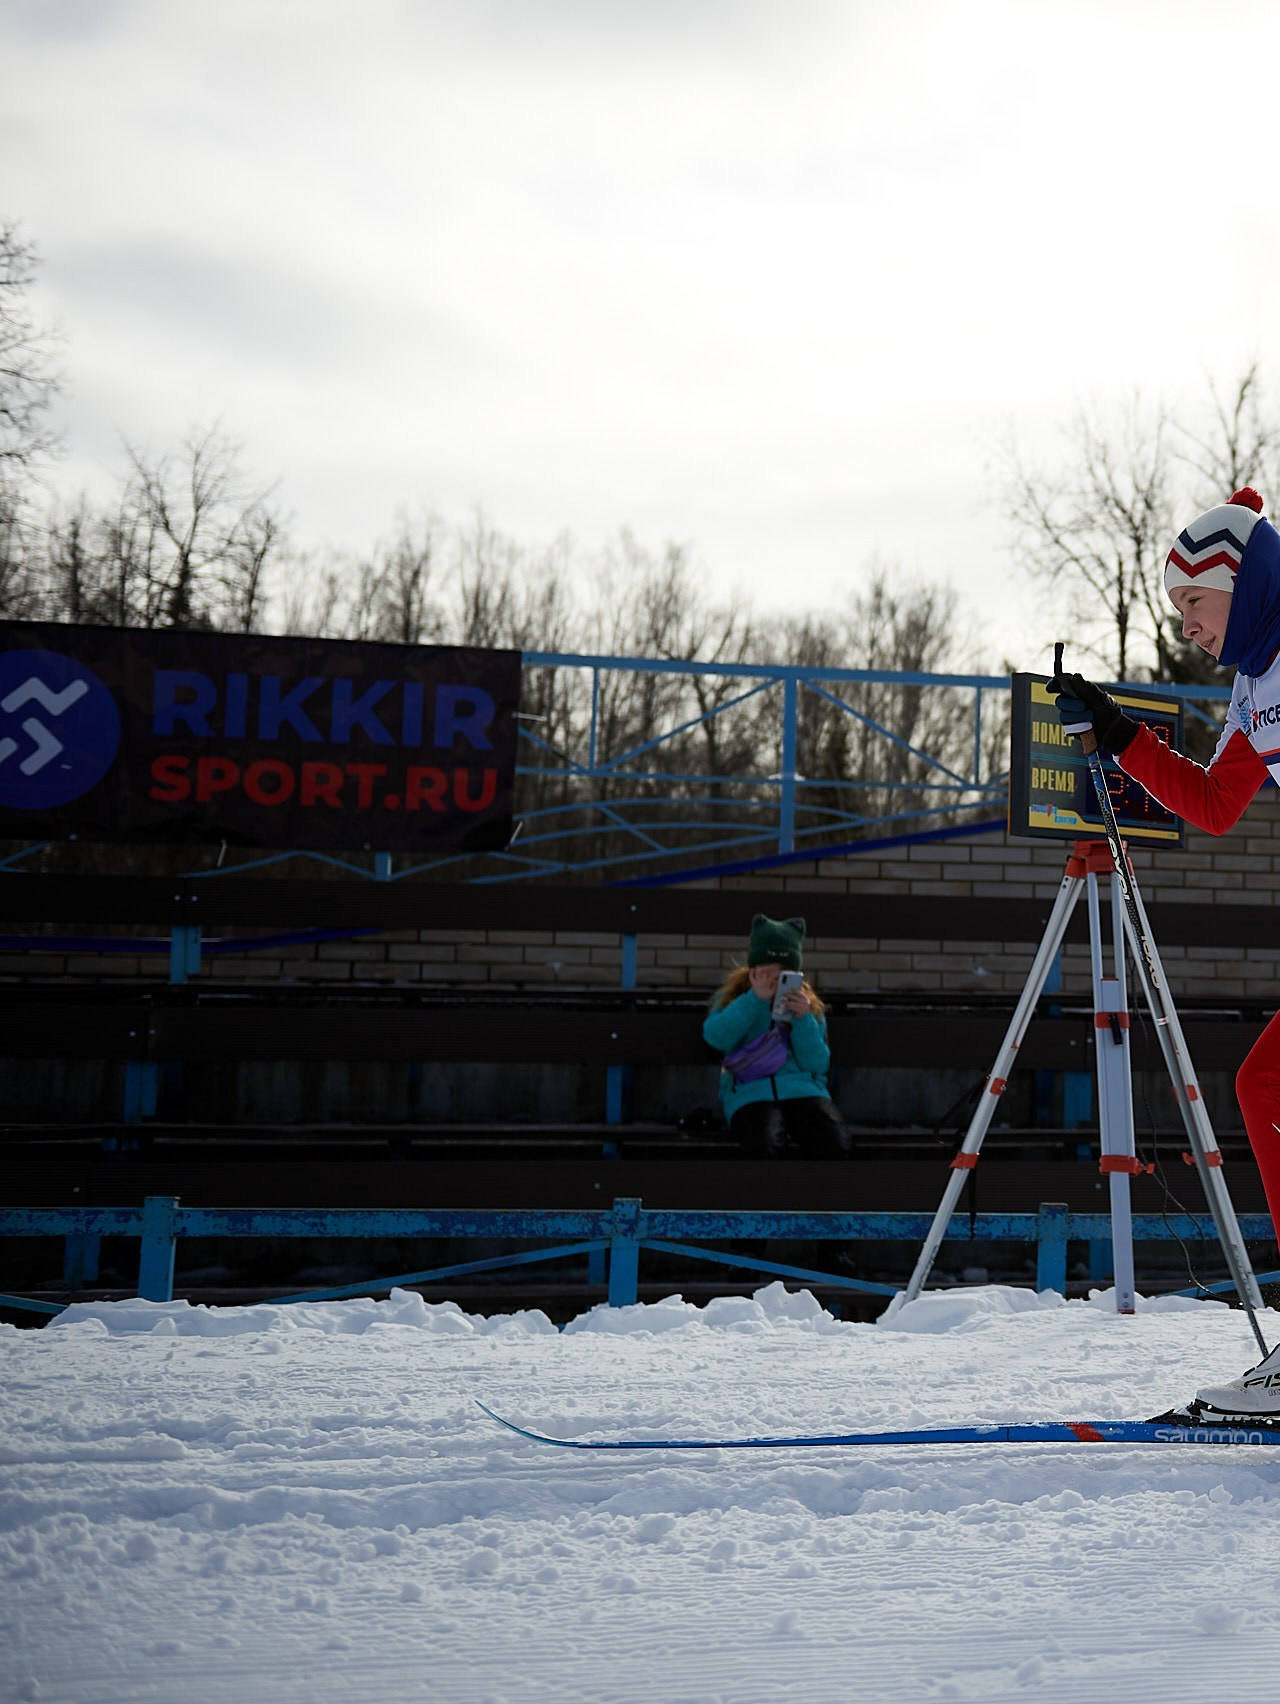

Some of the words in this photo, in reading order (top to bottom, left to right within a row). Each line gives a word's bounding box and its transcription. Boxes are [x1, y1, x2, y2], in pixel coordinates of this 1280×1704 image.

[152, 669, 497, 750] RIKKIR
[149, 755, 498, 812] SPORT.RU
[1031, 767, 1075, 793] ВРЕМЯ
[1154, 1428, 1263, 1444] salomon
